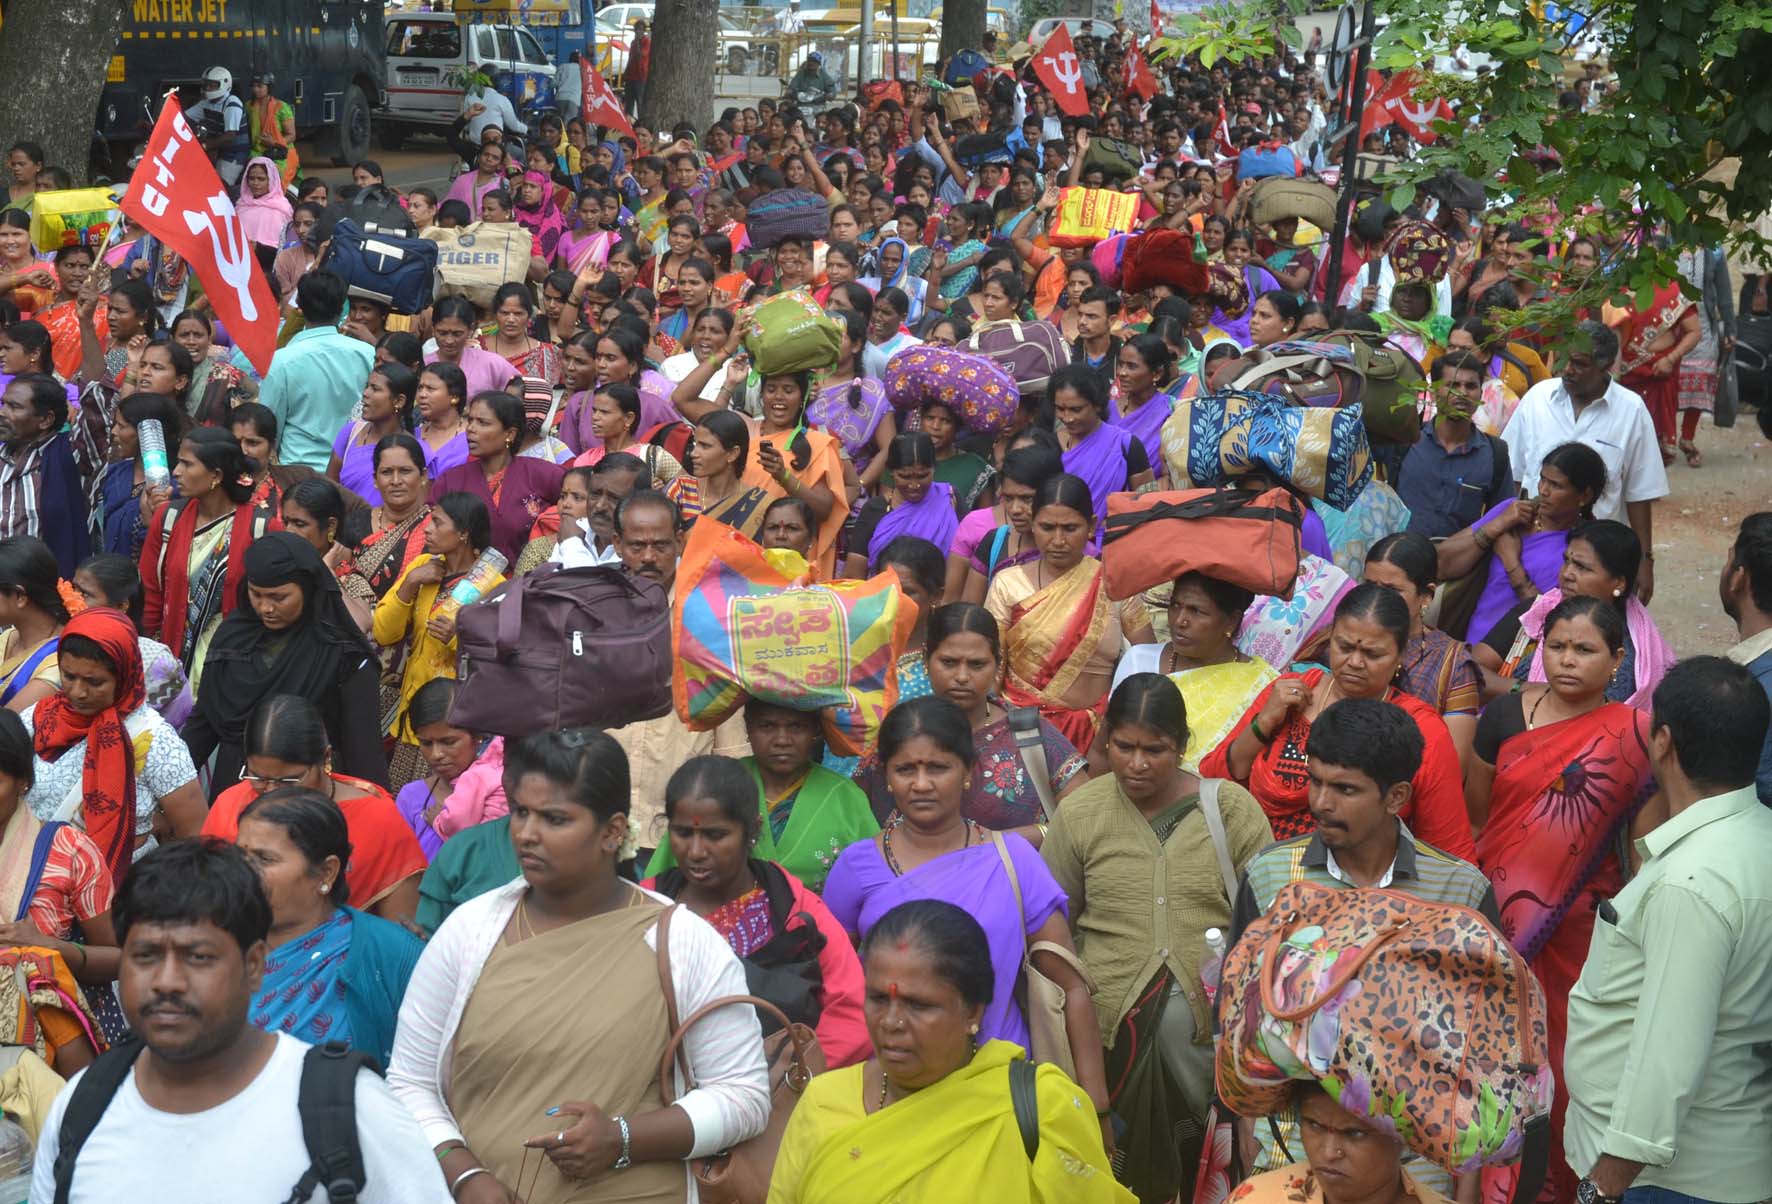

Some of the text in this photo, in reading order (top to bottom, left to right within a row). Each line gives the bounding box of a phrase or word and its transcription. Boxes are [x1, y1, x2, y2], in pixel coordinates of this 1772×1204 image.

[132, 0, 227, 23] WATER JET
[586, 65, 596, 113] AIAWU
[140, 111, 193, 218] CITU
[437, 251, 499, 265] TIGER
